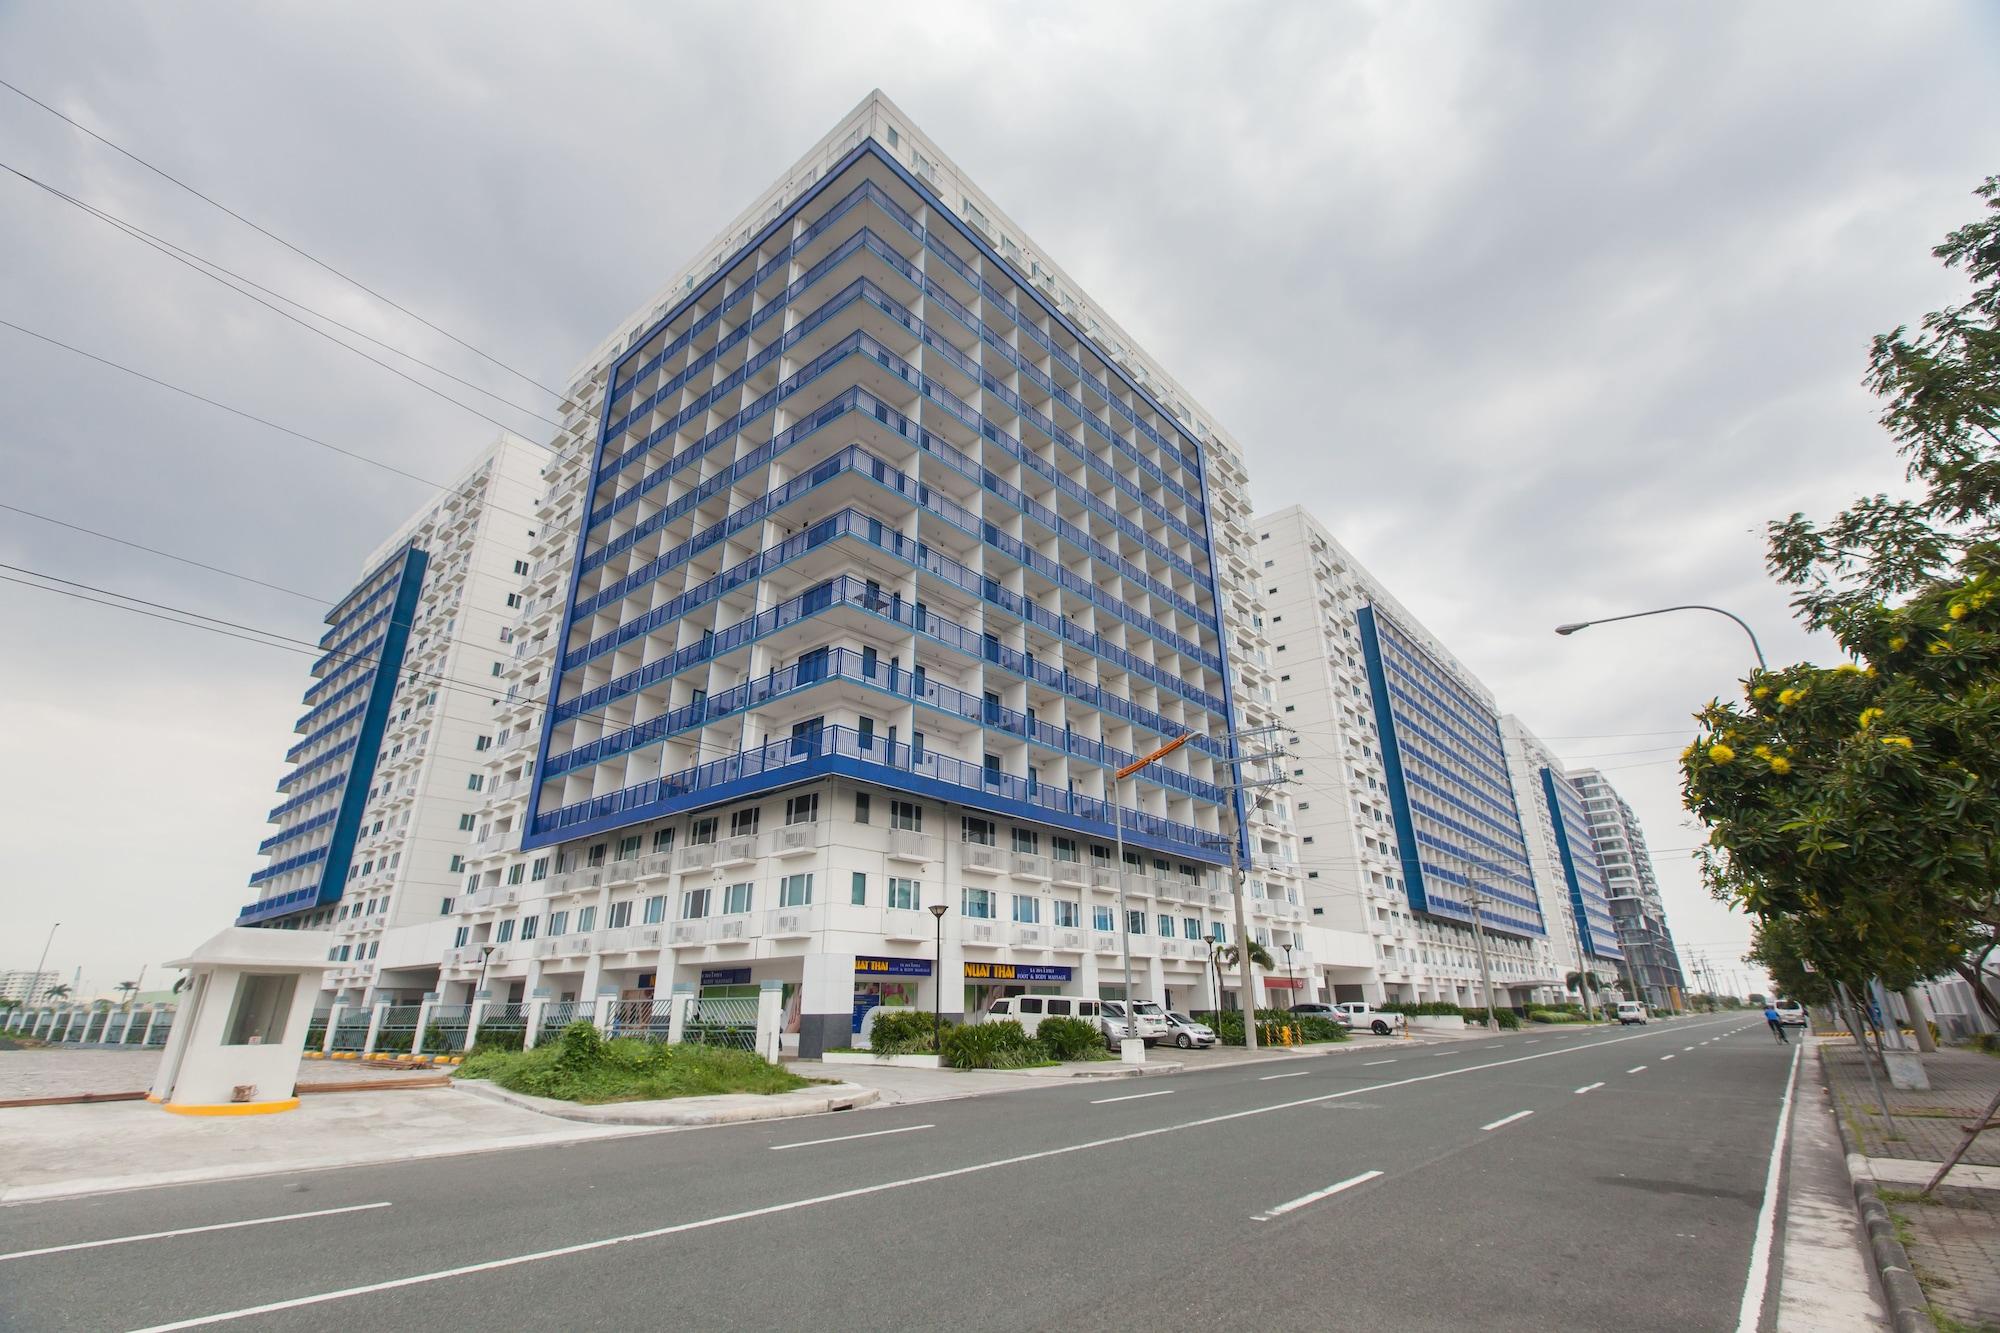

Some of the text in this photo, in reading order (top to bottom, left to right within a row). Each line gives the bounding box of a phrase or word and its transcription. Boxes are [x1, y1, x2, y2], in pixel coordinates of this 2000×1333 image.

[855, 960, 869, 970] UAT
[871, 961, 889, 971] THAI
[965, 963, 990, 978] NUAT
[994, 965, 1016, 979] THAI
